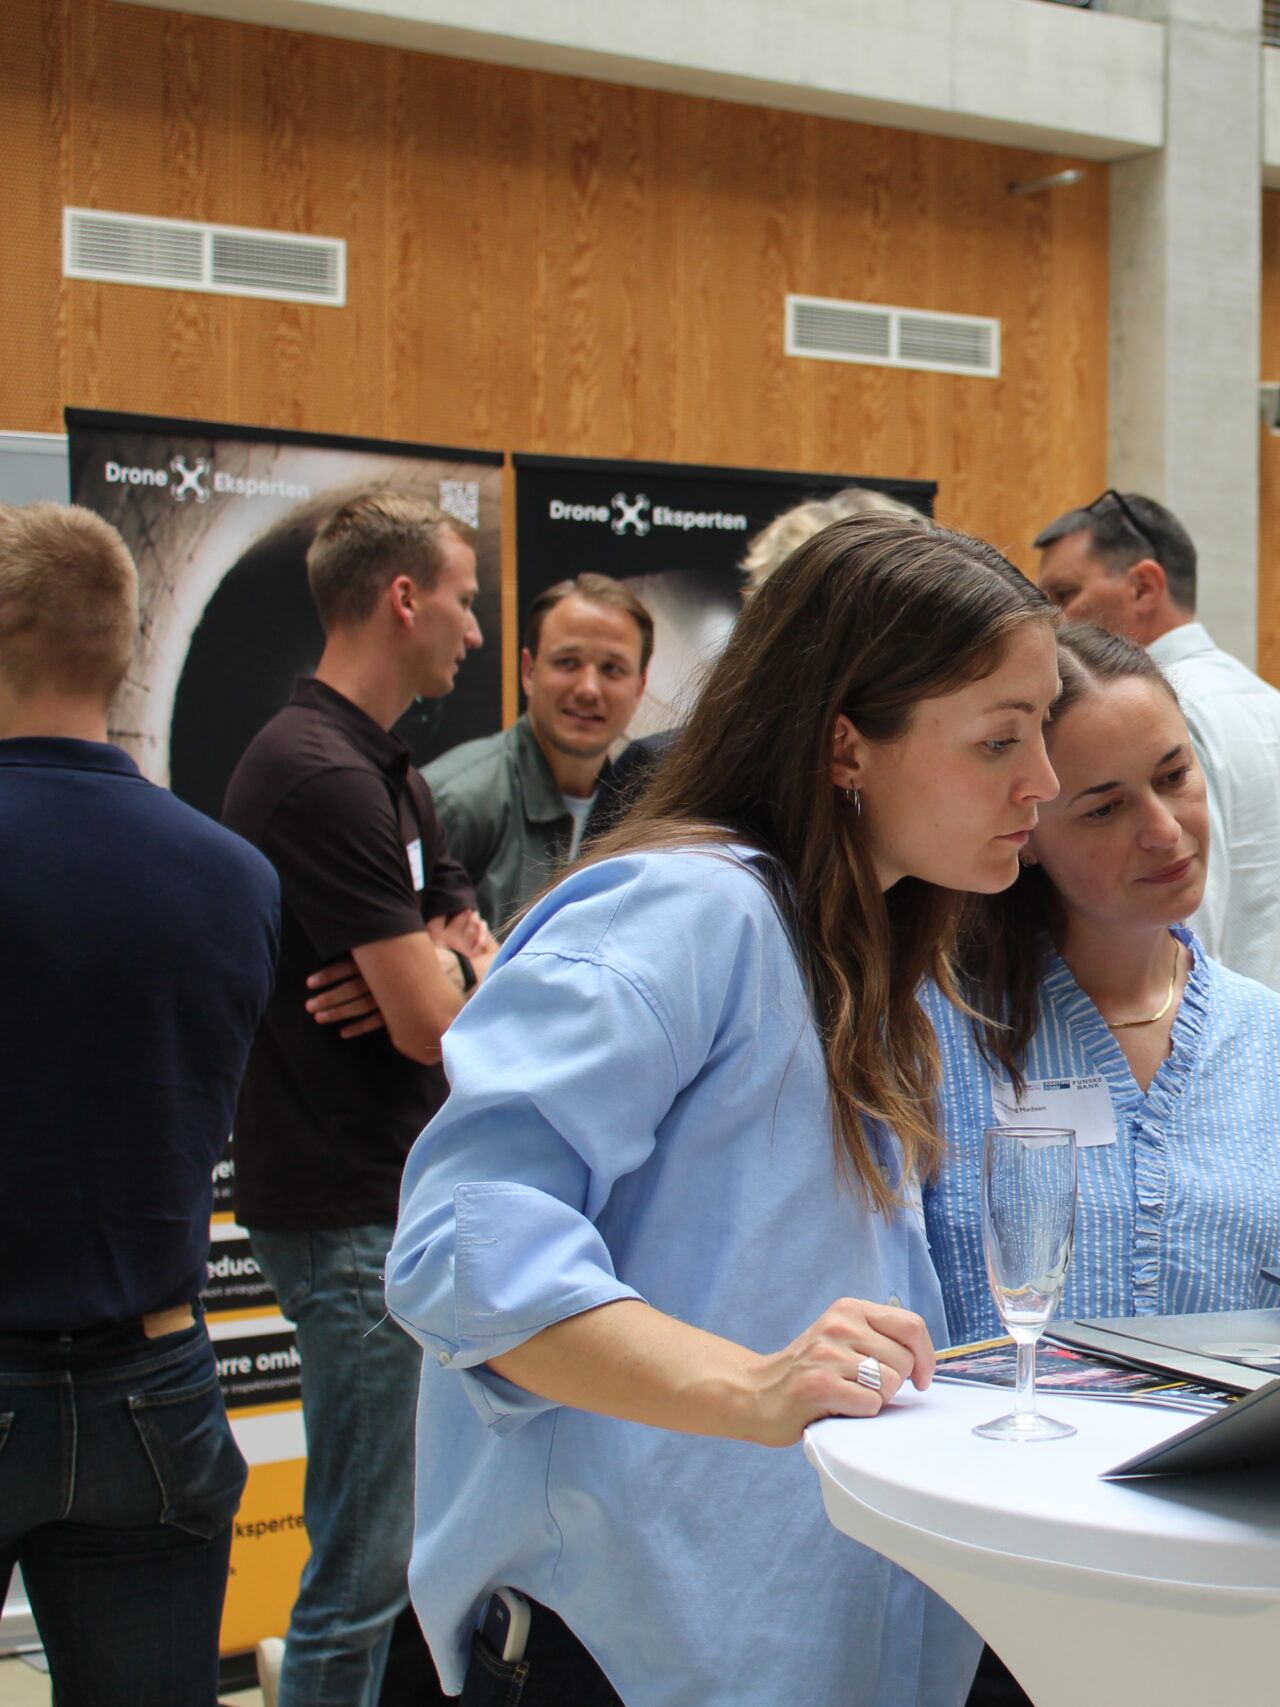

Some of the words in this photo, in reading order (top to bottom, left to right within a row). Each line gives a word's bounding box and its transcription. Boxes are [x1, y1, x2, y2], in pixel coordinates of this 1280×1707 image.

[105, 461, 168, 487] Drone
[213, 472, 310, 499] Eksperten
[550, 499, 610, 522] Drone
[652, 506, 748, 531] Eksperten
